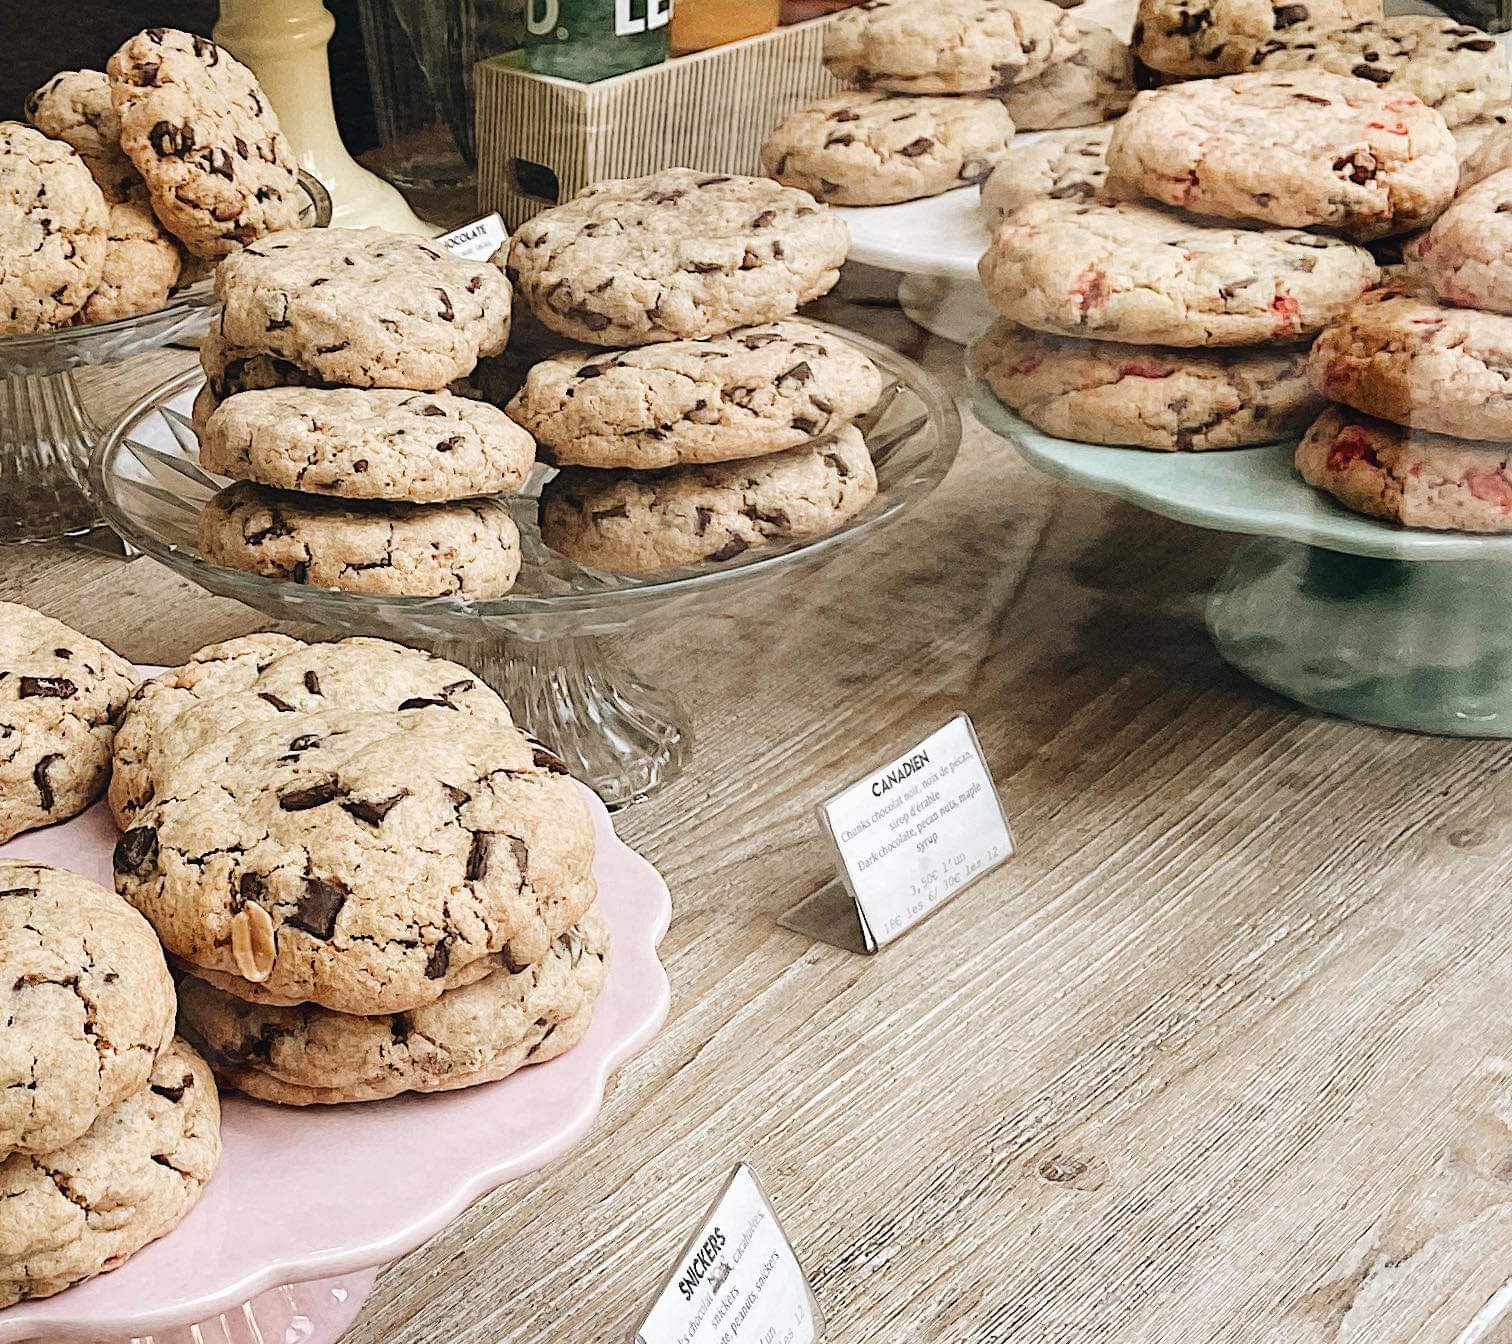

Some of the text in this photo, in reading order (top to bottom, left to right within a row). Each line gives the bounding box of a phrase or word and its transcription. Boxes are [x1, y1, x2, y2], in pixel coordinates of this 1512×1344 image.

[871, 749, 931, 798] CANADIEN
[857, 851, 879, 873] Dark
[916, 830, 939, 855] syrup
[678, 1227, 726, 1302] SNICKERS
[755, 1250, 780, 1293] snickers
[711, 1284, 740, 1330] snickers
